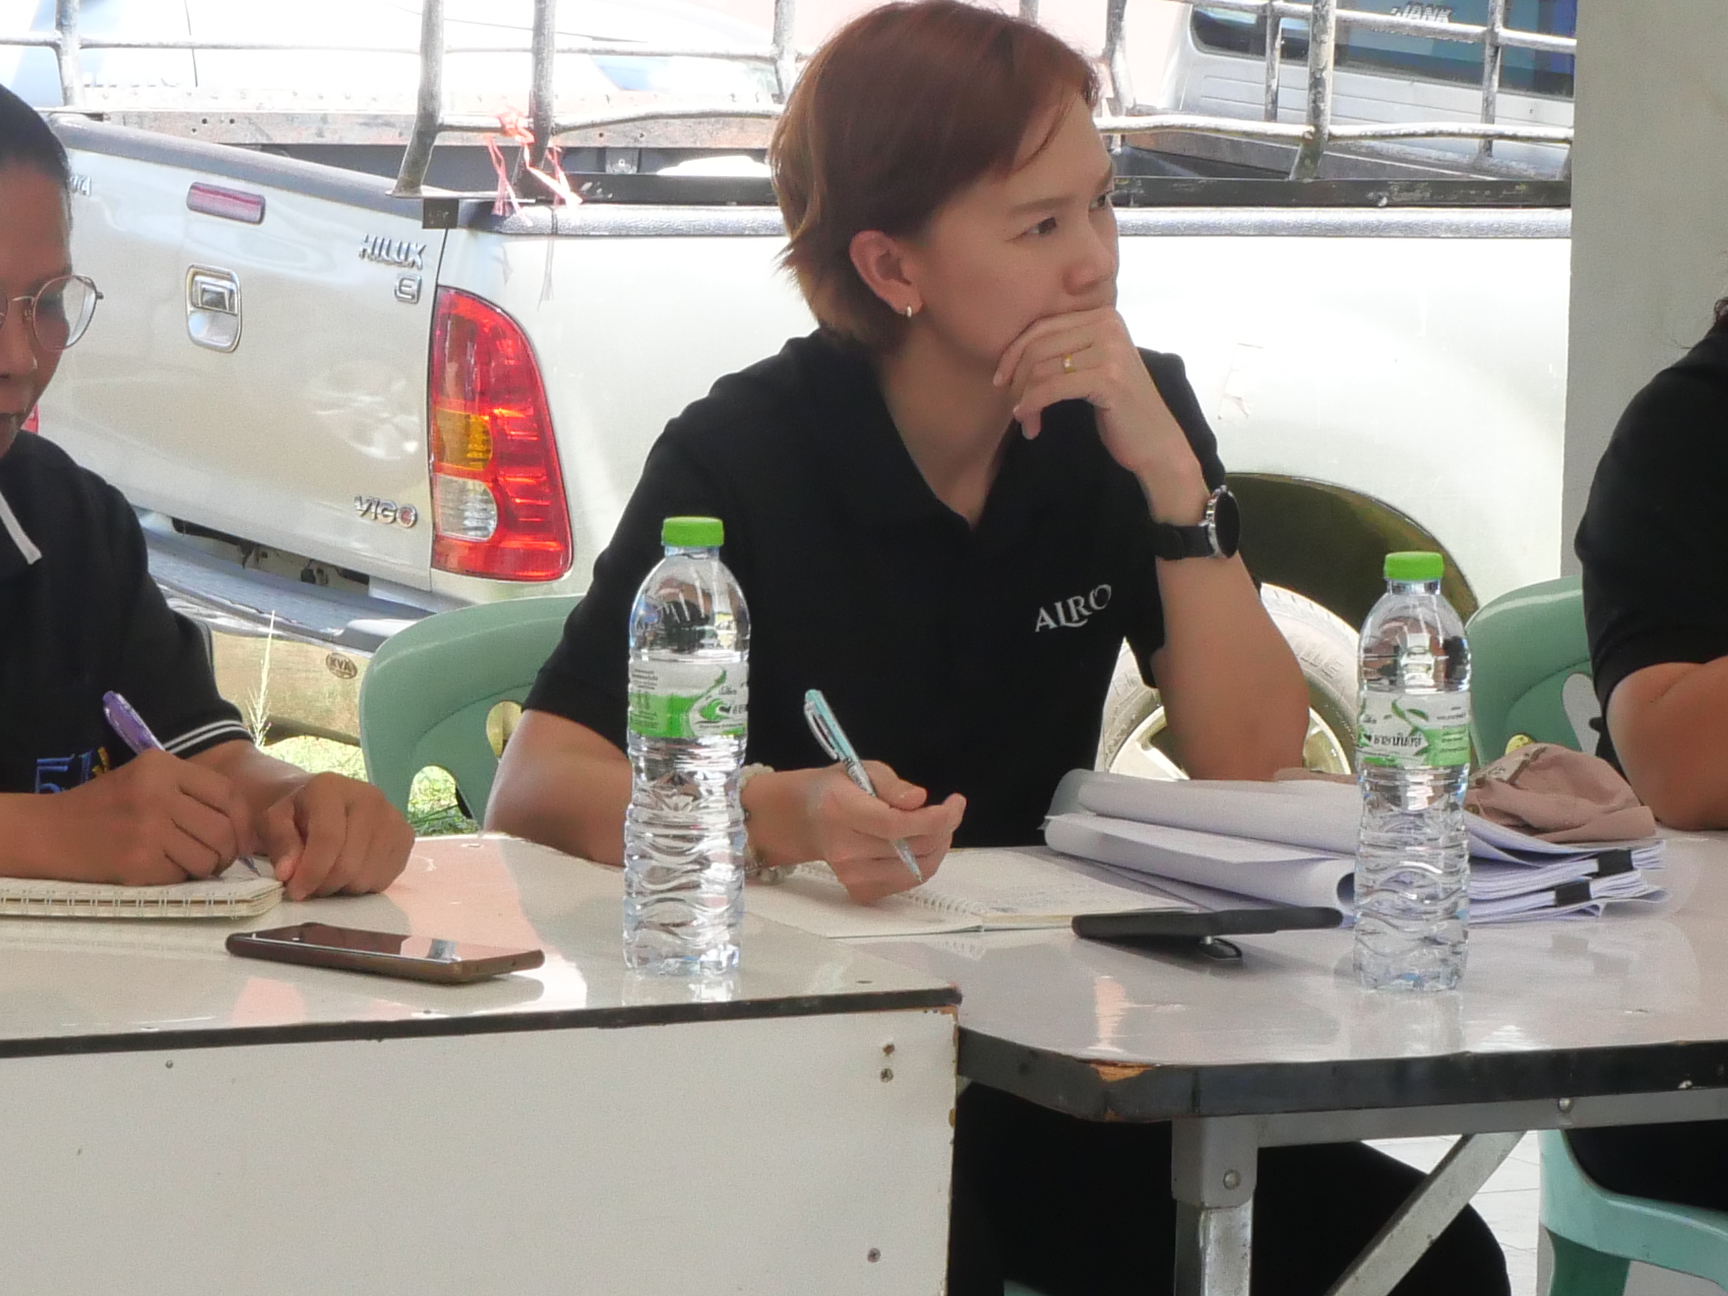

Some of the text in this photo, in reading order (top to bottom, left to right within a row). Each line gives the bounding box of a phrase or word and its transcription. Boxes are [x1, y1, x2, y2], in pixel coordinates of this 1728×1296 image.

[359, 234, 427, 270] HILUX
[354, 495, 418, 528] VIGO
[1035, 584, 1112, 632] ALRO
